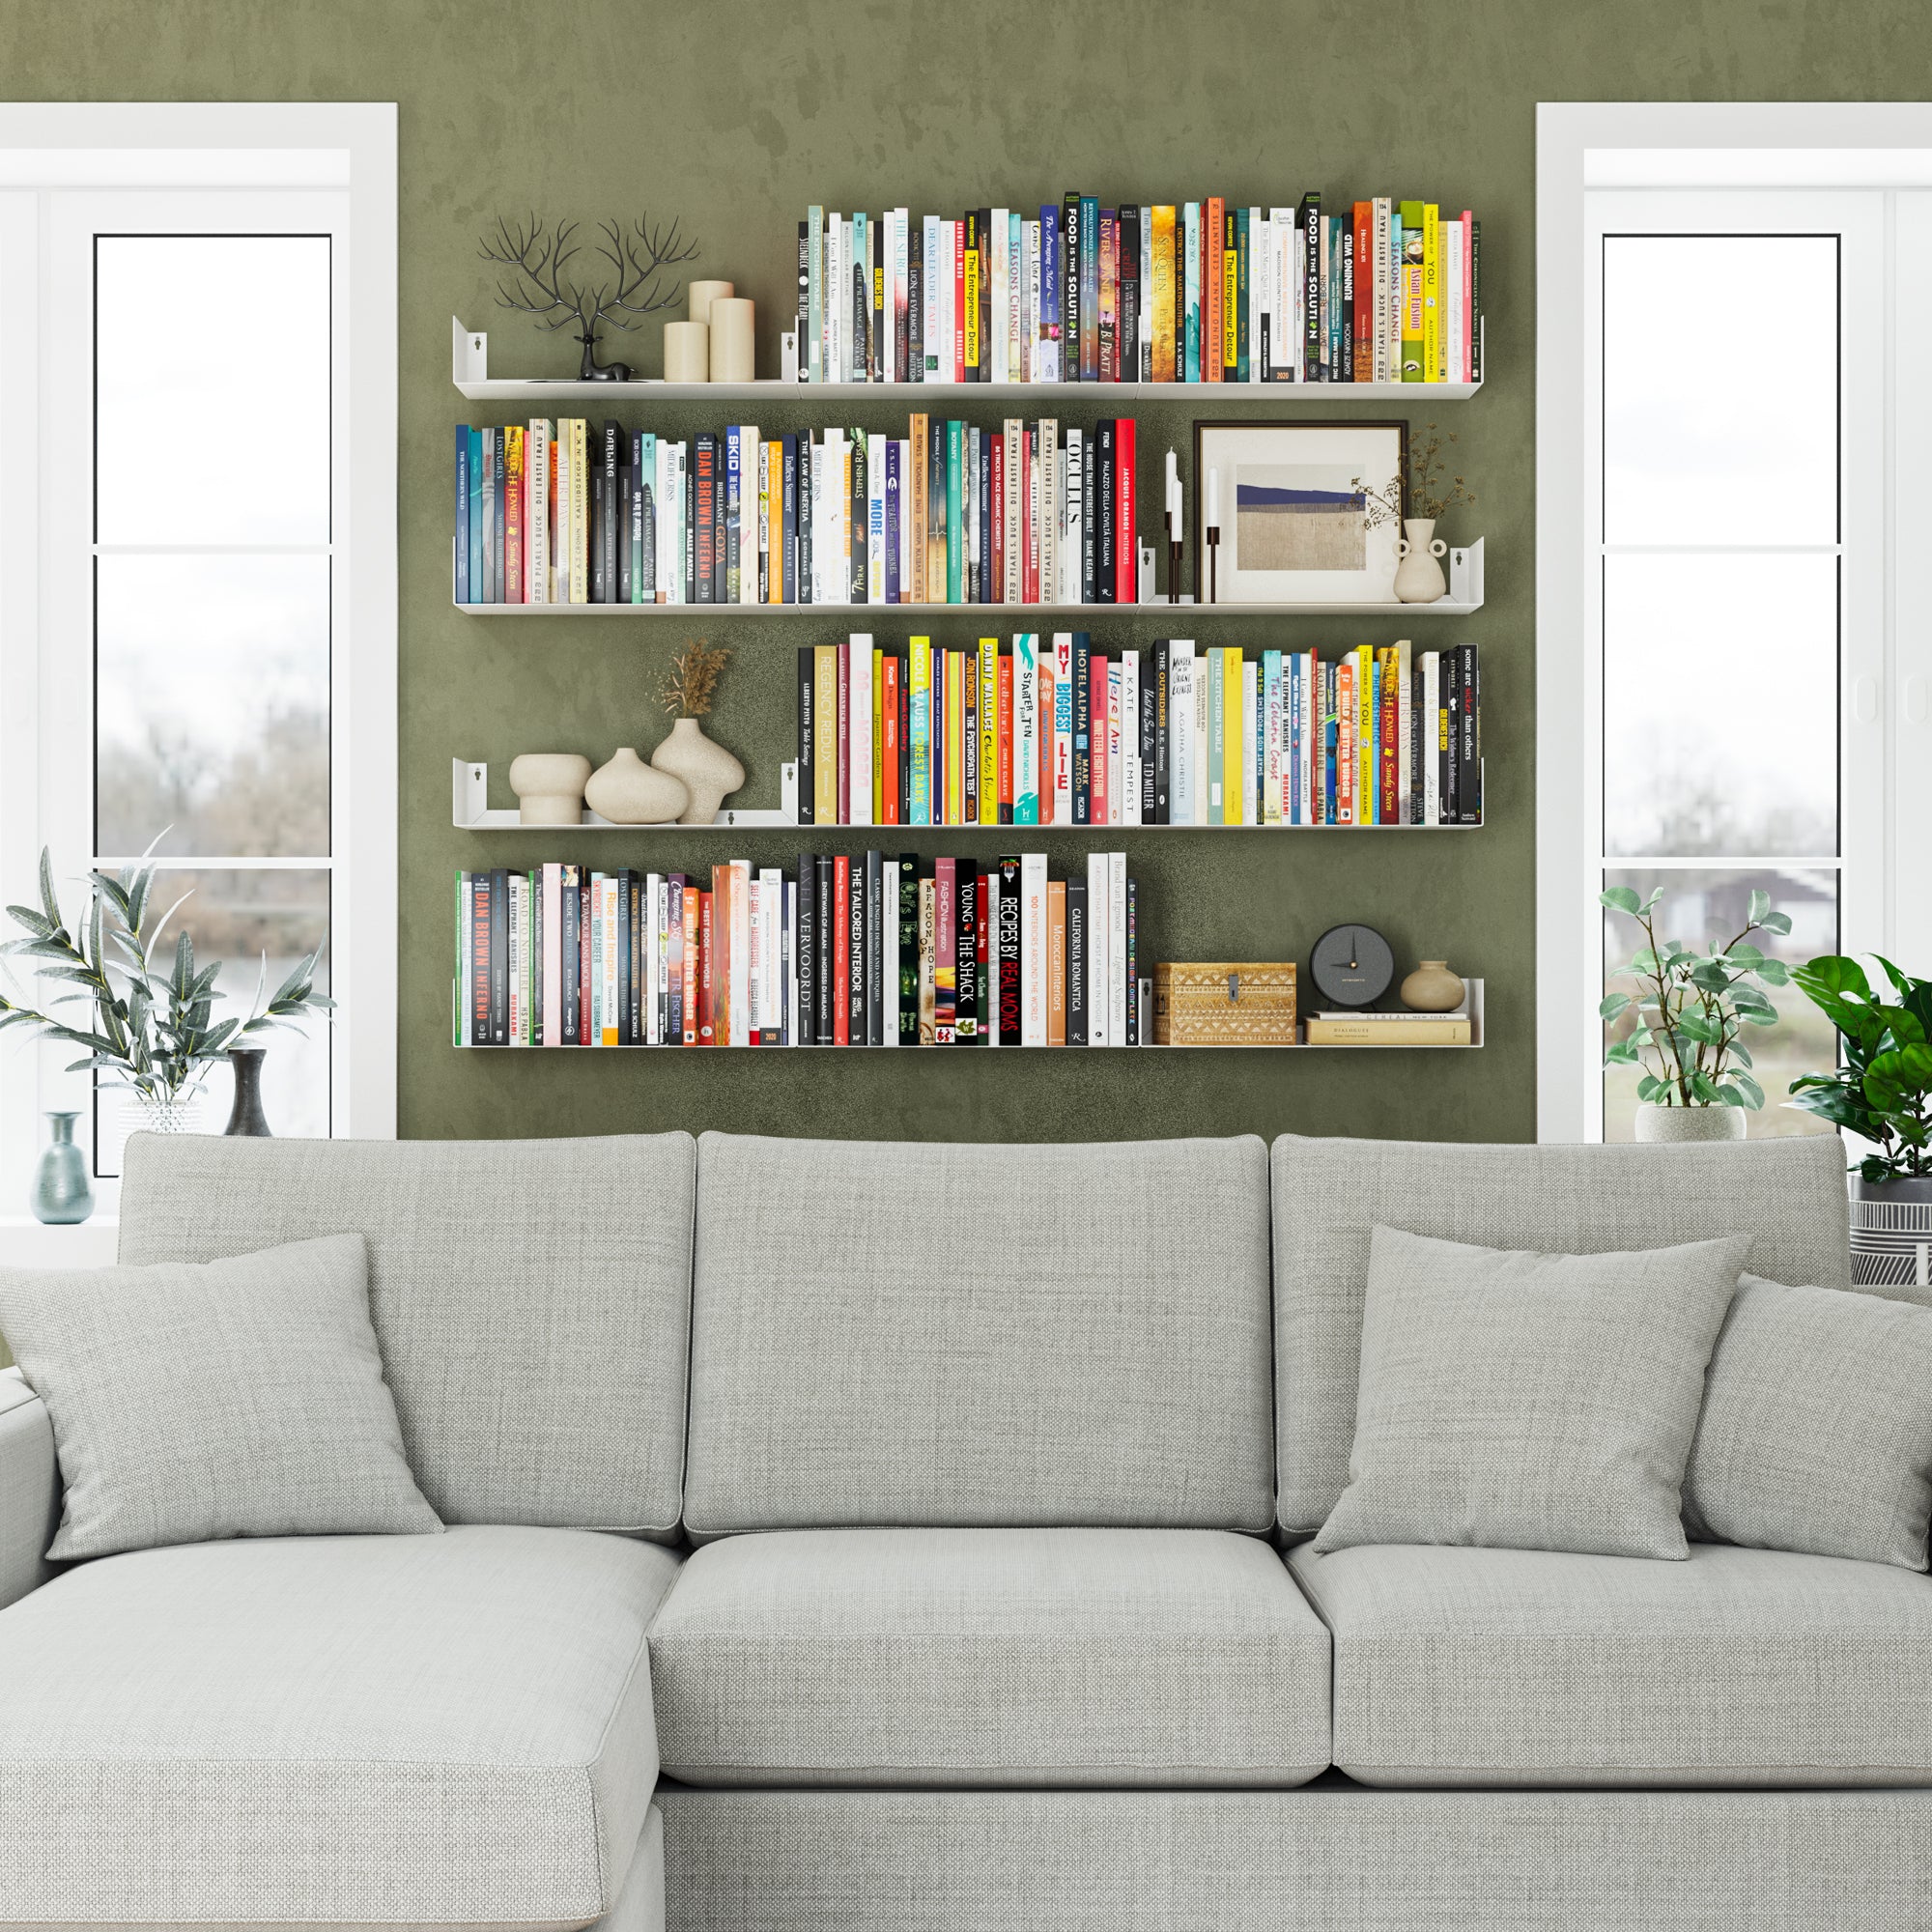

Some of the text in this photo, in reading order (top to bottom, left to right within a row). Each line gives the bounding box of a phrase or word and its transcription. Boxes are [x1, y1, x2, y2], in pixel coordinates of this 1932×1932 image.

[895, 218, 906, 278] THE SURGE
[1068, 209, 1077, 243] FOOD
[1068, 258, 1077, 272] THE
[927, 228, 936, 337] DEAR LEADER TALES
[967, 256, 976, 360] The Entrepreneur Detour
[1225, 256, 1234, 360] The Entrepreneur Detour
[1391, 242, 1400, 343] SEASONS CHANGE
[1410, 269, 1422, 329] Asian Fusion
[606, 429, 614, 477] DARLING
[729, 436, 738, 470] SKID
[802, 478, 809, 488] OF
[1068, 444, 1081, 524] OCULUS
[698, 451, 711, 579] DAN BROWN INFERNO
[717, 526, 725, 563] GOYA
[870, 499, 882, 535] MORE
[508, 541, 518, 589] Sandy Steen
[966, 657, 976, 707] JON RONSON
[983, 644, 993, 679] DANNY
[1021, 672, 1033, 711] STARTER
[1077, 649, 1086, 730] HOTEL ALPHA
[821, 656, 831, 762] REGENCY REDUX
[914, 644, 924, 803] NICOLE KRAUSS FOREST DARK
[983, 682, 993, 731] WALLACE
[1022, 719, 1032, 737] TEN
[1056, 644, 1071, 789] MY BIGGEST LIE
[966, 715, 976, 796] THE PSYCHOPATH TEST
[983, 776, 993, 800] Street
[1144, 779, 1153, 810] MILLER
[475, 893, 489, 1019] DAN BROWN INFERNO
[605, 893, 616, 981] Rise and Inspire
[801, 864, 810, 1011] AXEL VERVOORDT
[852, 867, 862, 991] THE TAILORED INTERIOR
[960, 882, 974, 1002] YOUNG THE SHACK
[1001, 897, 1018, 1031] RECIPES BY REAL MOMS
[1072, 908, 1081, 1011] CALIFORNIA ROMANTICA
